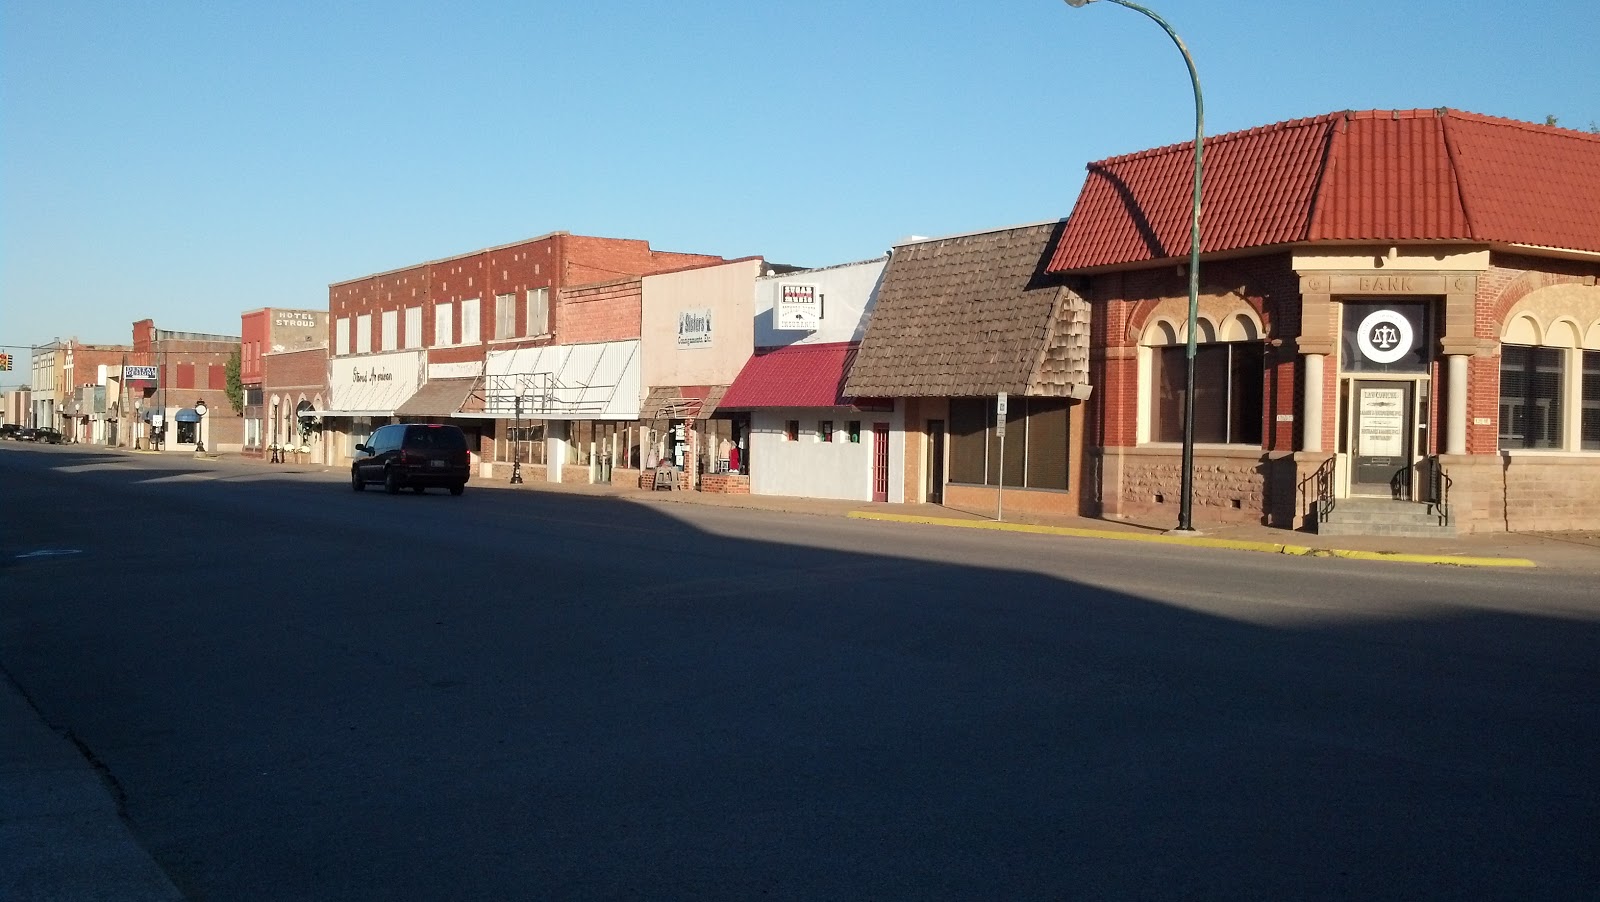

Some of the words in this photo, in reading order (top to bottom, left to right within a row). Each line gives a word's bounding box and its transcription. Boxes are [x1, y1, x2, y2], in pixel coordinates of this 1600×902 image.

[1359, 277, 1414, 291] BANK
[279, 312, 314, 320] HOTEL
[275, 319, 315, 328] STROUD
[684, 312, 705, 333] Sisters
